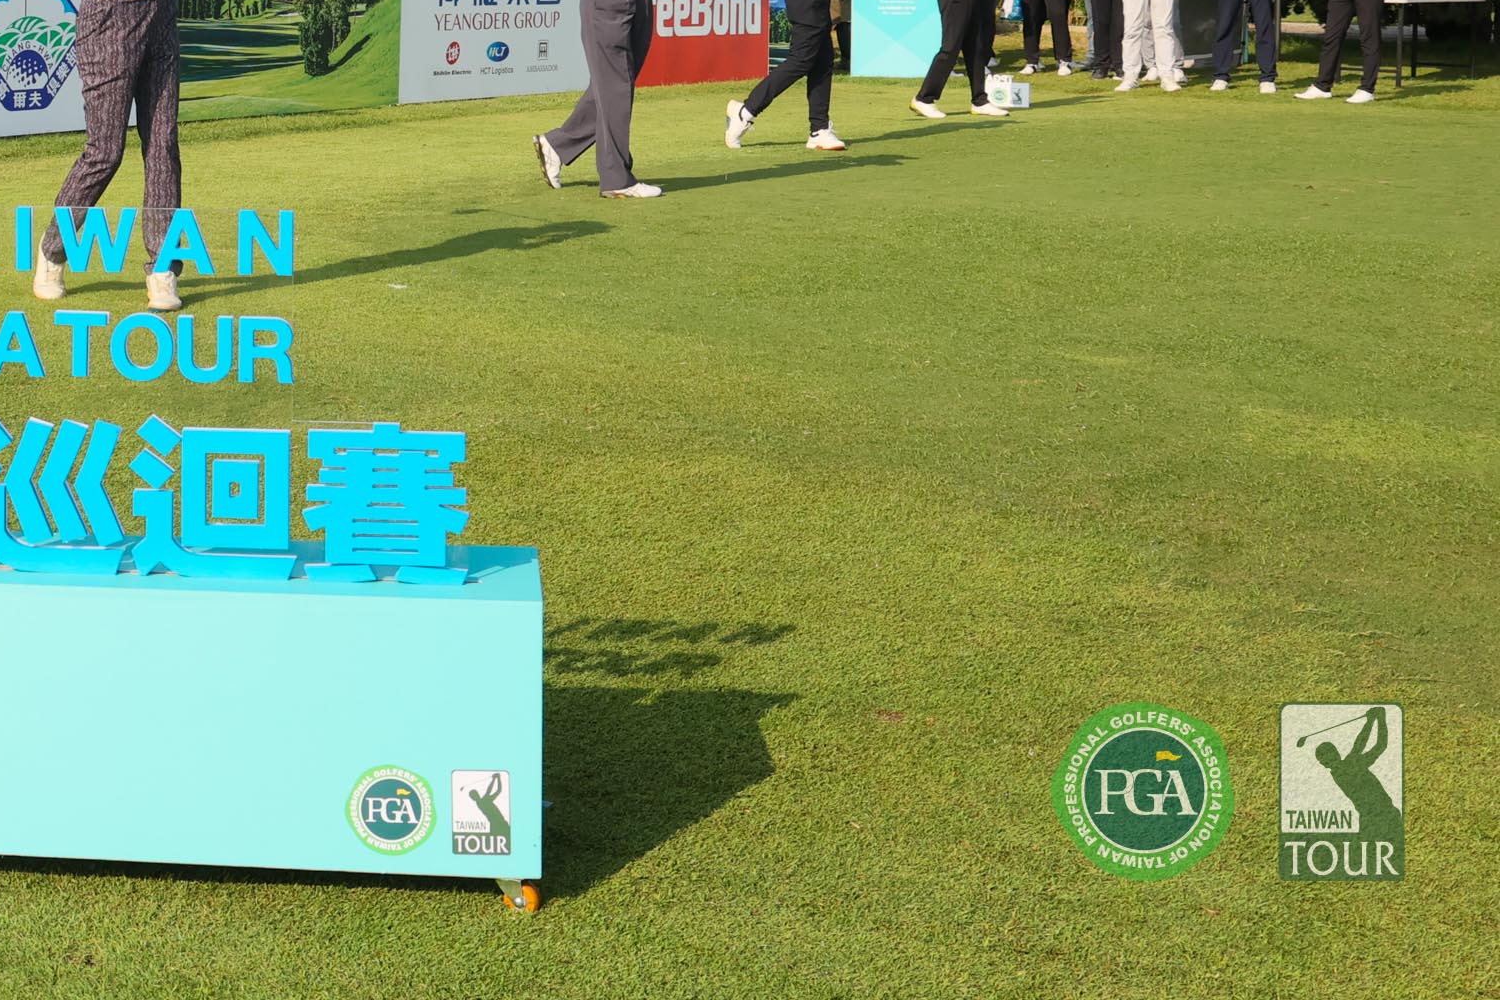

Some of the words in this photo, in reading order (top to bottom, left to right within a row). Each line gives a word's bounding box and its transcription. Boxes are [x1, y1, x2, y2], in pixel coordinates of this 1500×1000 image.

[434, 12, 510, 31] YEANGDER
[514, 10, 561, 29] GROUP
[53, 310, 295, 385] TOUR
[365, 797, 418, 824] PGA
[455, 820, 487, 830] TAIWAN
[454, 835, 509, 853] TOUR
